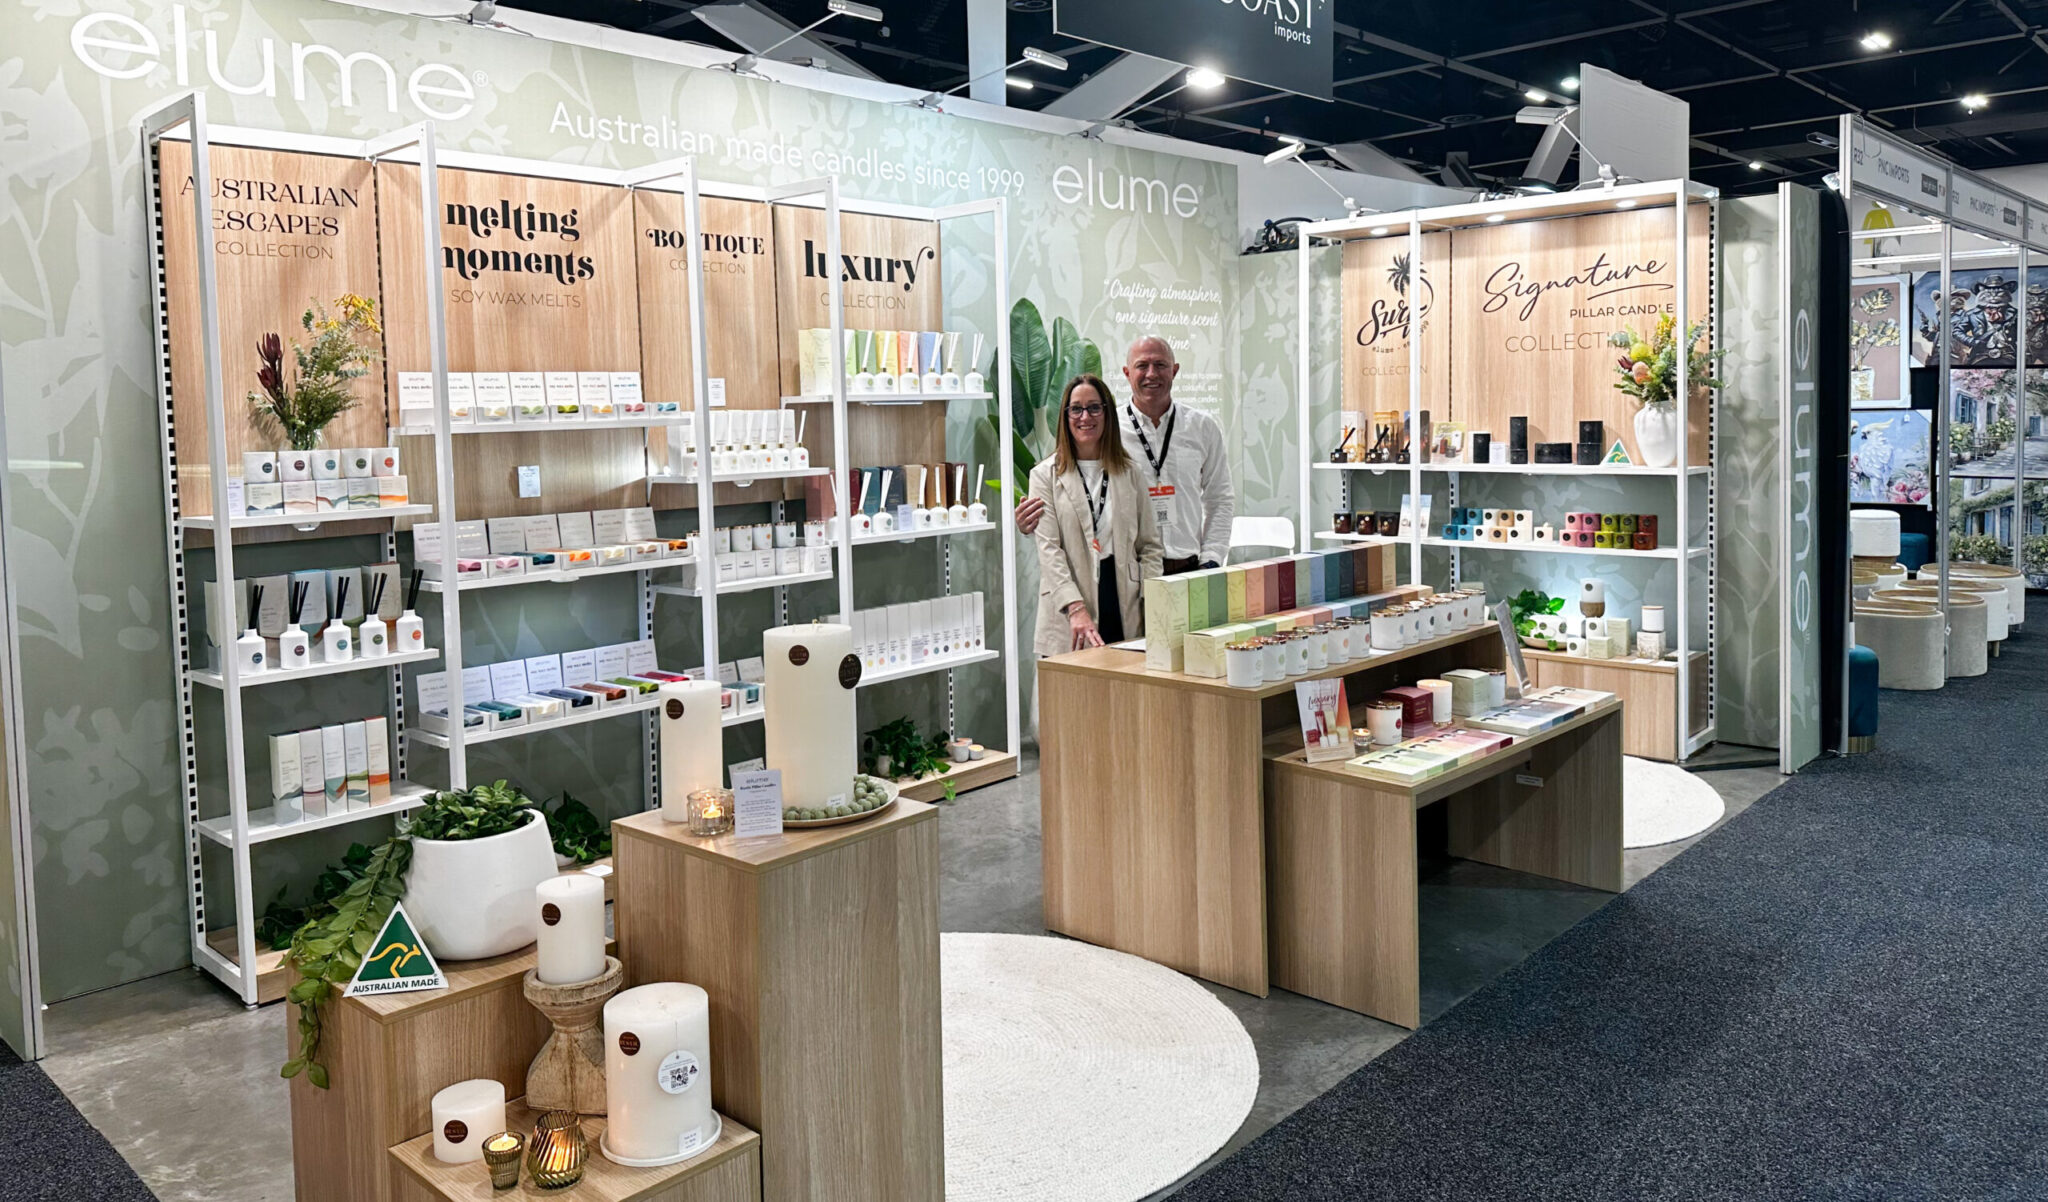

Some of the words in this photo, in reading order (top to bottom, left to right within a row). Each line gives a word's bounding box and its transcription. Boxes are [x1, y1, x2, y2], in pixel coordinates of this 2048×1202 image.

[1274, 21, 1311, 45] imports
[549, 101, 715, 156] Australian
[726, 134, 802, 168] made
[812, 147, 906, 182] candles
[915, 161, 971, 190] since
[977, 166, 1025, 197] 1999
[212, 209, 339, 236] ESCAPES
[446, 199, 580, 242] melting
[215, 240, 333, 260] COLLECTION
[646, 228, 764, 259] BOTIQUE
[441, 246, 595, 286] moments
[669, 259, 746, 275] COECTION
[1483, 253, 1668, 321] Signature
[451, 289, 484, 303] SOY
[488, 292, 527, 305] WAX
[531, 293, 581, 308] MELTS
[820, 292, 906, 310] CLLECTION
[1115, 311, 1136, 323] one
[1138, 310, 1189, 329] signature
[1191, 312, 1218, 326] scent
[1570, 306, 1614, 318] PILLAR
[1619, 303, 1674, 318] CANDE
[1362, 365, 1428, 376] COLLECTN
[1794, 309, 1815, 633] elume
[352, 980, 409, 993] AUSTRALIAN
[411, 978, 440, 989] MADE
